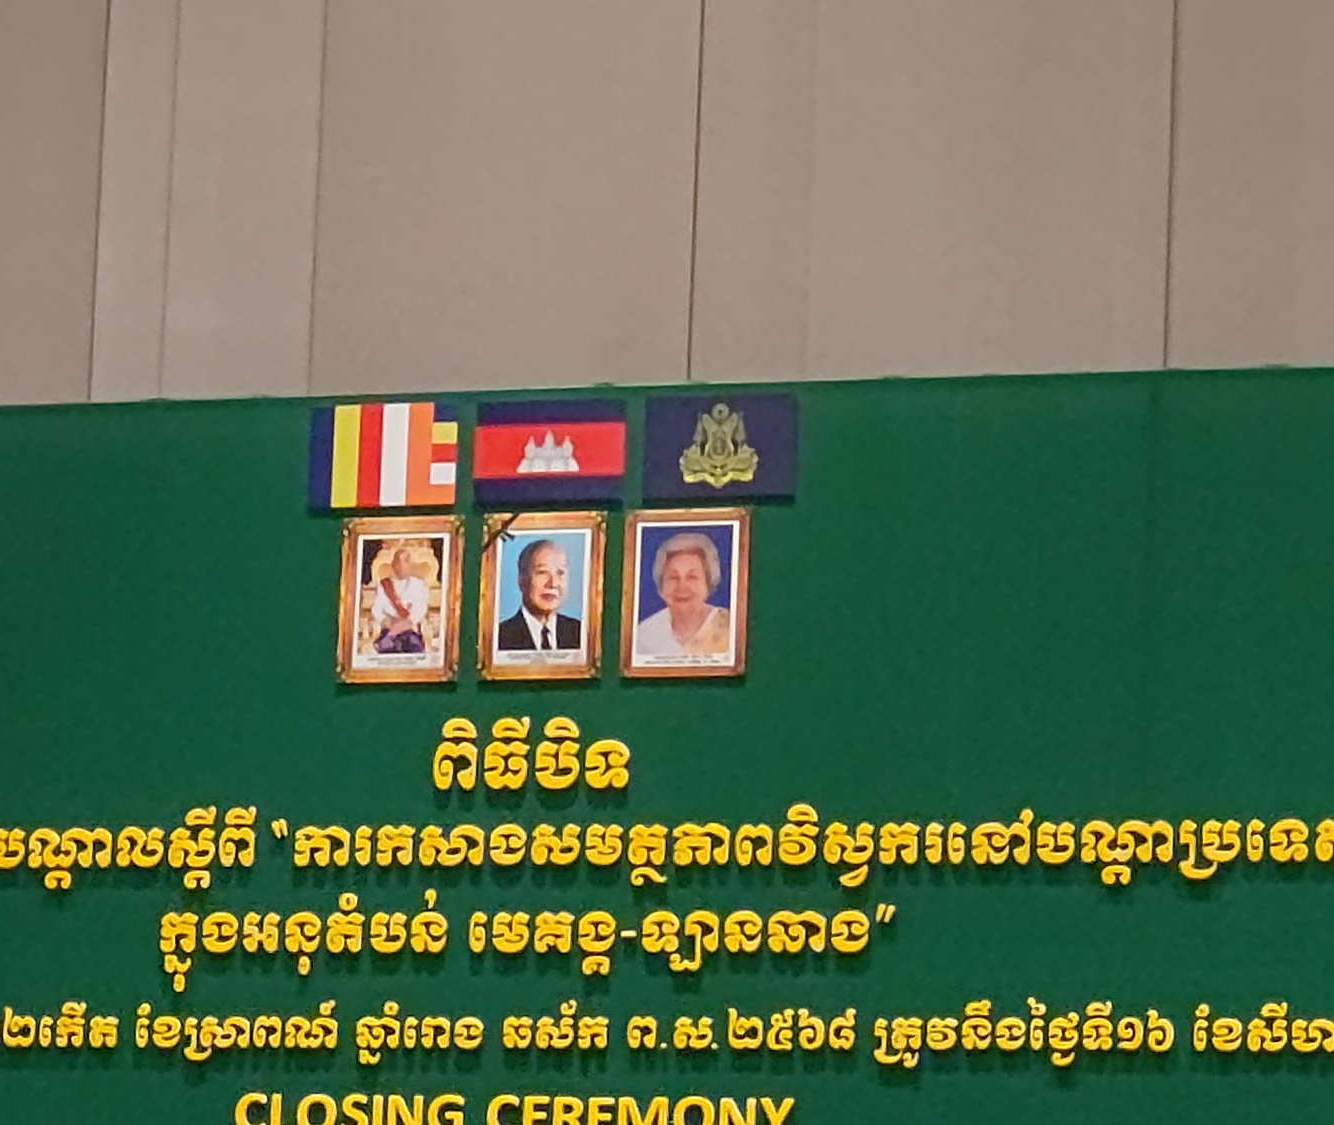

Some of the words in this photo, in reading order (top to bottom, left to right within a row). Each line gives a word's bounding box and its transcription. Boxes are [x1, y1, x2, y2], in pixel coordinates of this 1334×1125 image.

[433, 717, 630, 790] ពិធីបិទ
[160, 889, 447, 993] ក្នុងអនុតំបន់
[136, 1000, 339, 1061] ខែស្រាពណ៍
[356, 1000, 484, 1065] ឆ្នាំរោង
[503, 1000, 609, 1049] ឆស័ក
[874, 997, 1175, 1068] ត្រូវនឹងថ្ងៃទី១៦
